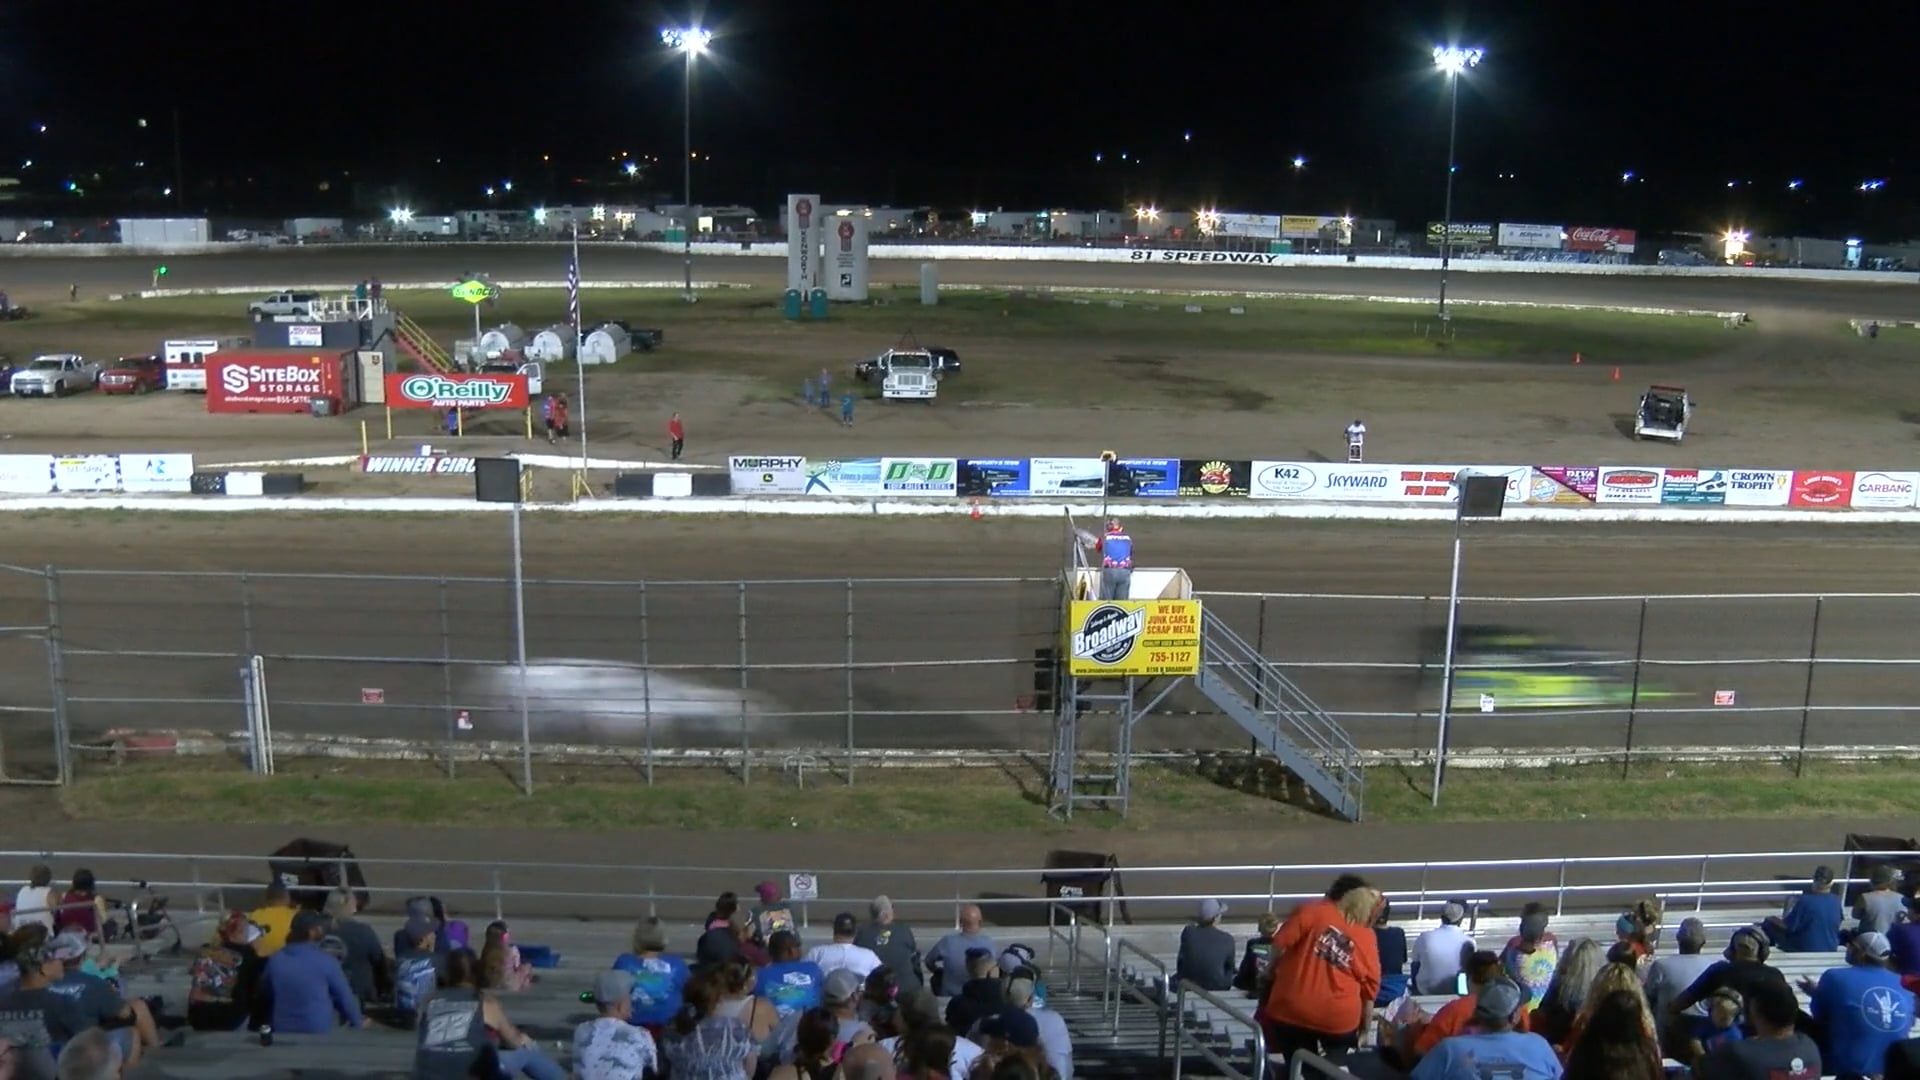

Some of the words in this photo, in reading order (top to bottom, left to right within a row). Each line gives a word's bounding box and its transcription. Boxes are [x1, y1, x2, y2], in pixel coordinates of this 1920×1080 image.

[800, 231, 808, 280] KENWORTH
[1130, 251, 1152, 260] 81
[1162, 251, 1279, 264] SPEEDWAY
[260, 384, 320, 393] STORAGE
[404, 377, 510, 403] O'Reilly
[366, 457, 436, 473] WINNER
[733, 458, 803, 468] MURPHY
[1274, 468, 1300, 479] K42
[1665, 474, 1698, 482] Makita
[1731, 472, 1775, 481] CROWN
[1326, 472, 1387, 488] SKYWARD
[1730, 481, 1774, 490] TROPHY
[1158, 605, 1171, 614] WE
[1172, 605, 1186, 614] BUY
[1147, 615, 1168, 624] JUNK
[1168, 615, 1188, 624] CARS
[1074, 610, 1144, 656] Broadway
[1147, 625, 1171, 634] SCRAP
[1173, 625, 1195, 634] METAL
[1150, 651, 1191, 663] 755-1127
